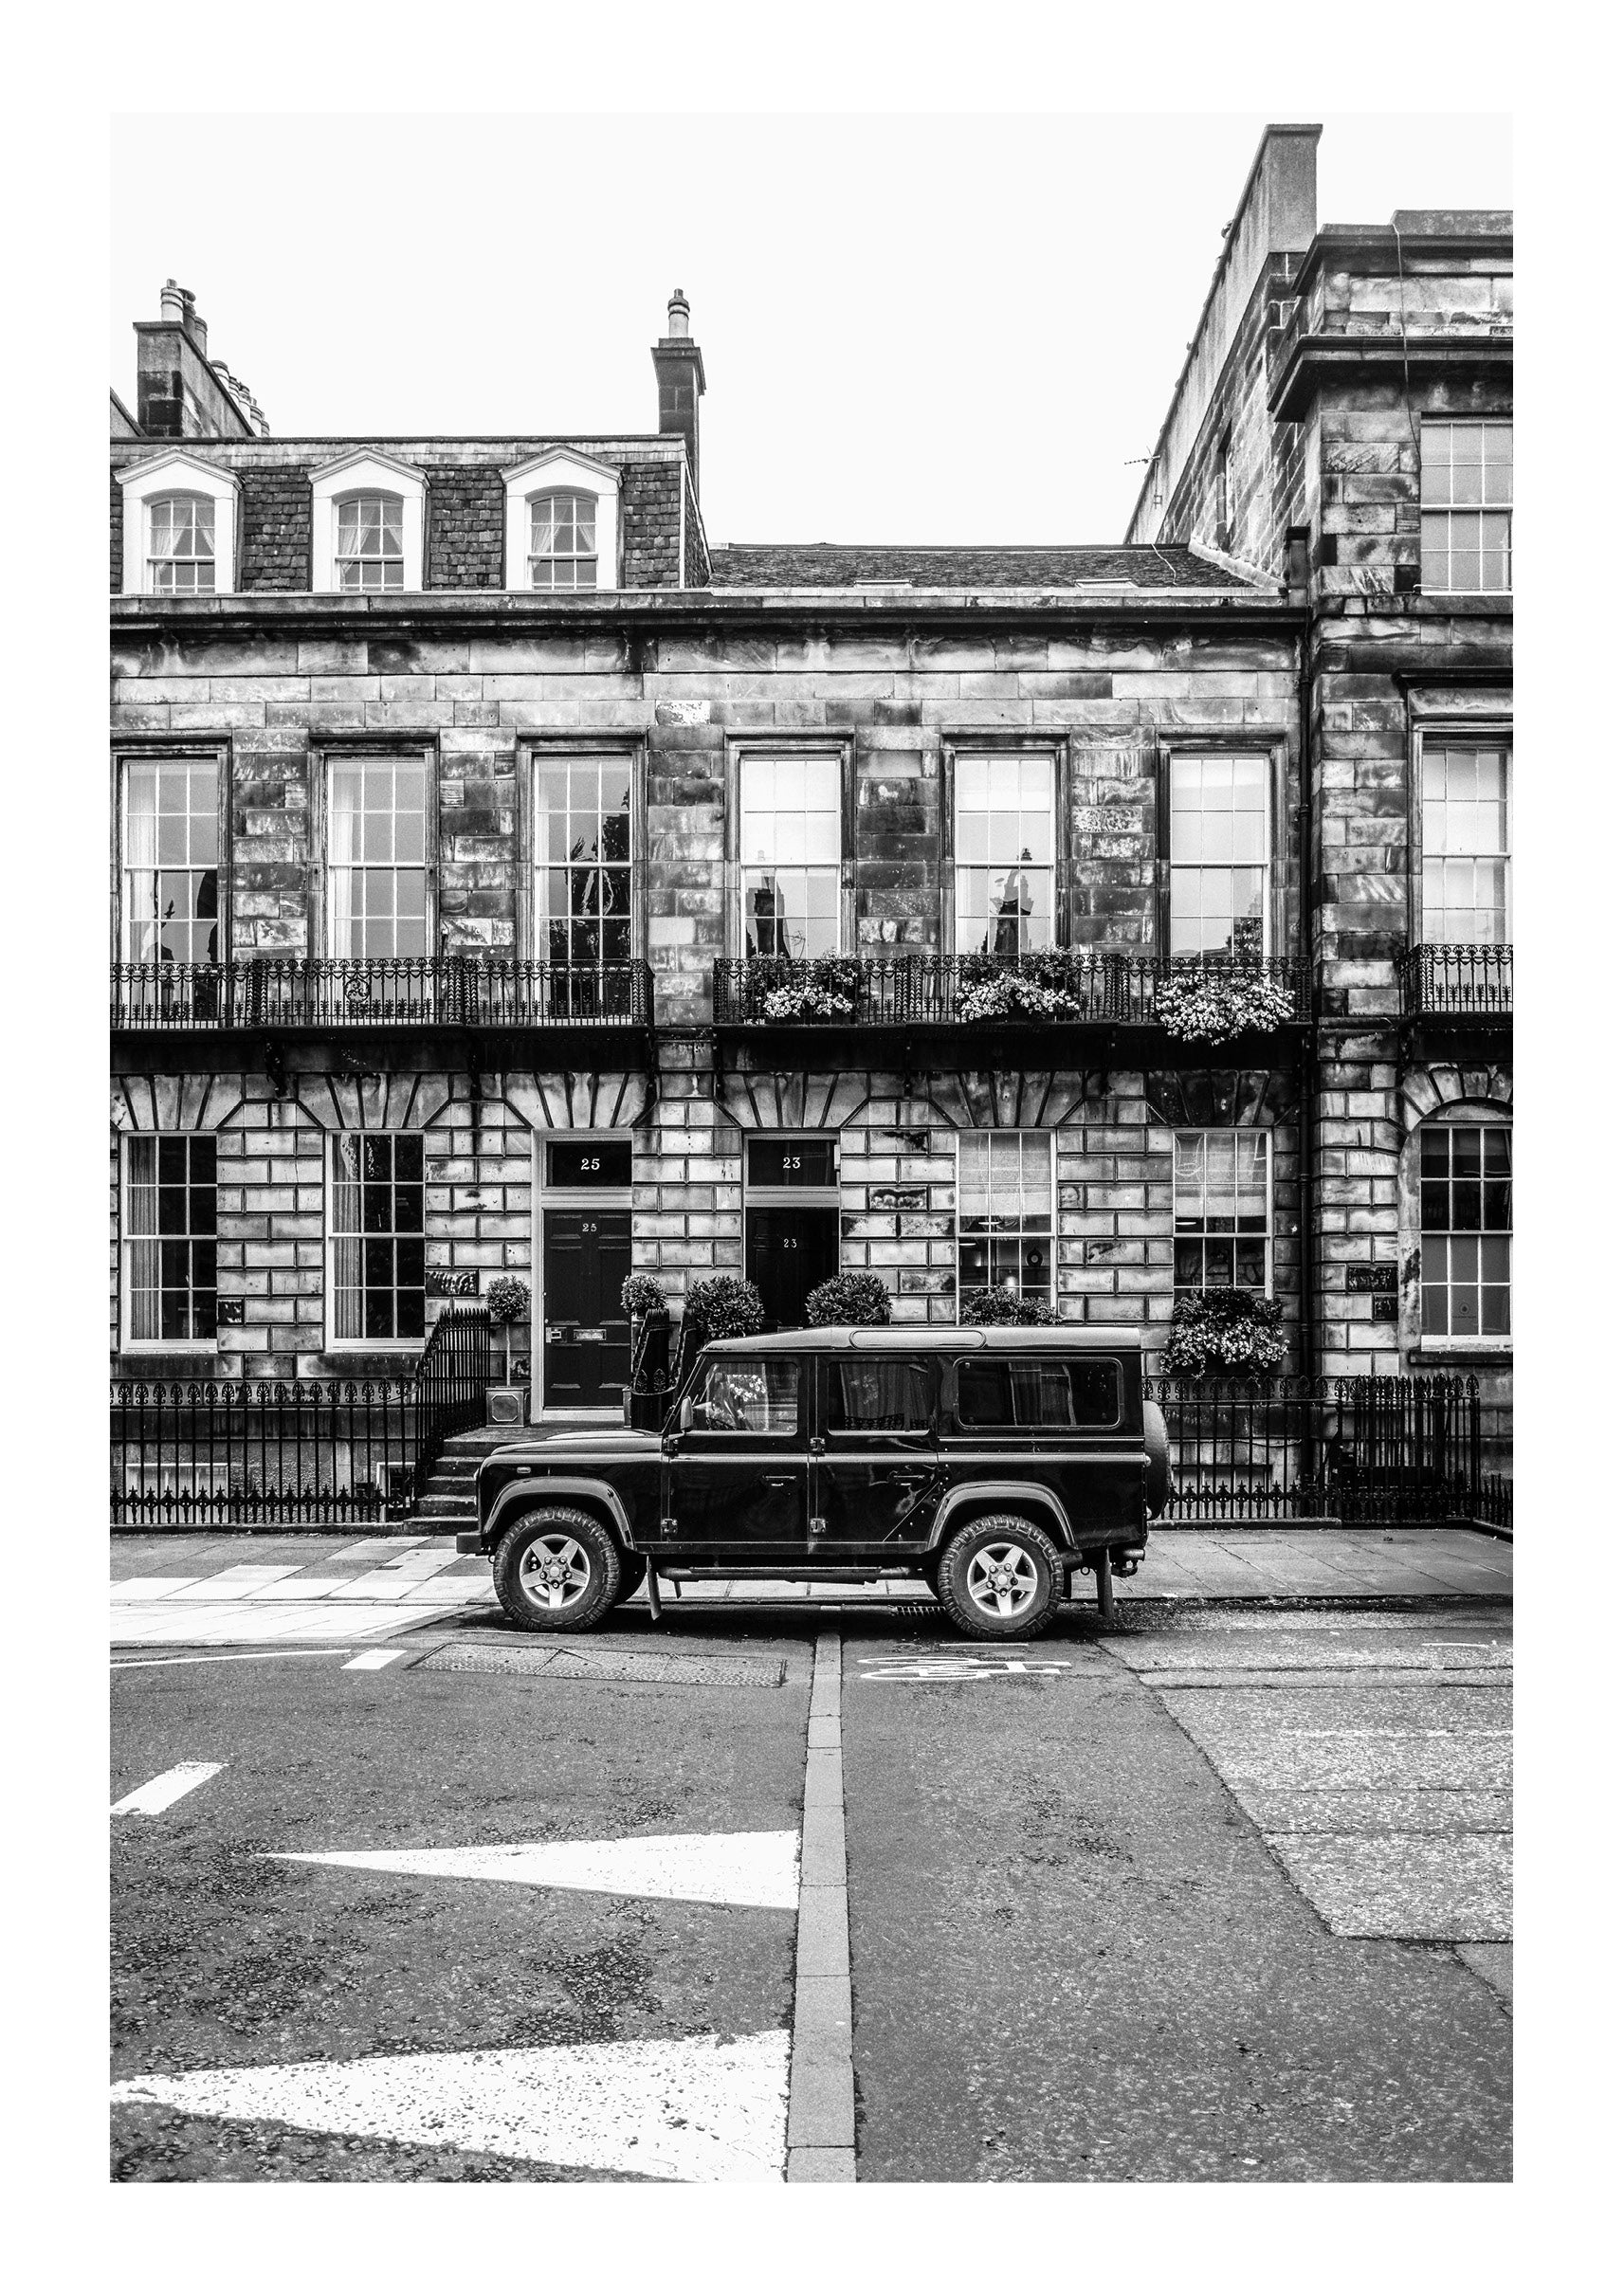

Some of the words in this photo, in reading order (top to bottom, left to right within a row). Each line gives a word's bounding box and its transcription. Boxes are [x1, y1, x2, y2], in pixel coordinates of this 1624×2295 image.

[580, 1157, 600, 1171] 25
[782, 1157, 801, 1169] 23
[581, 1223, 597, 1232] 25
[783, 1238, 797, 1248] 23
